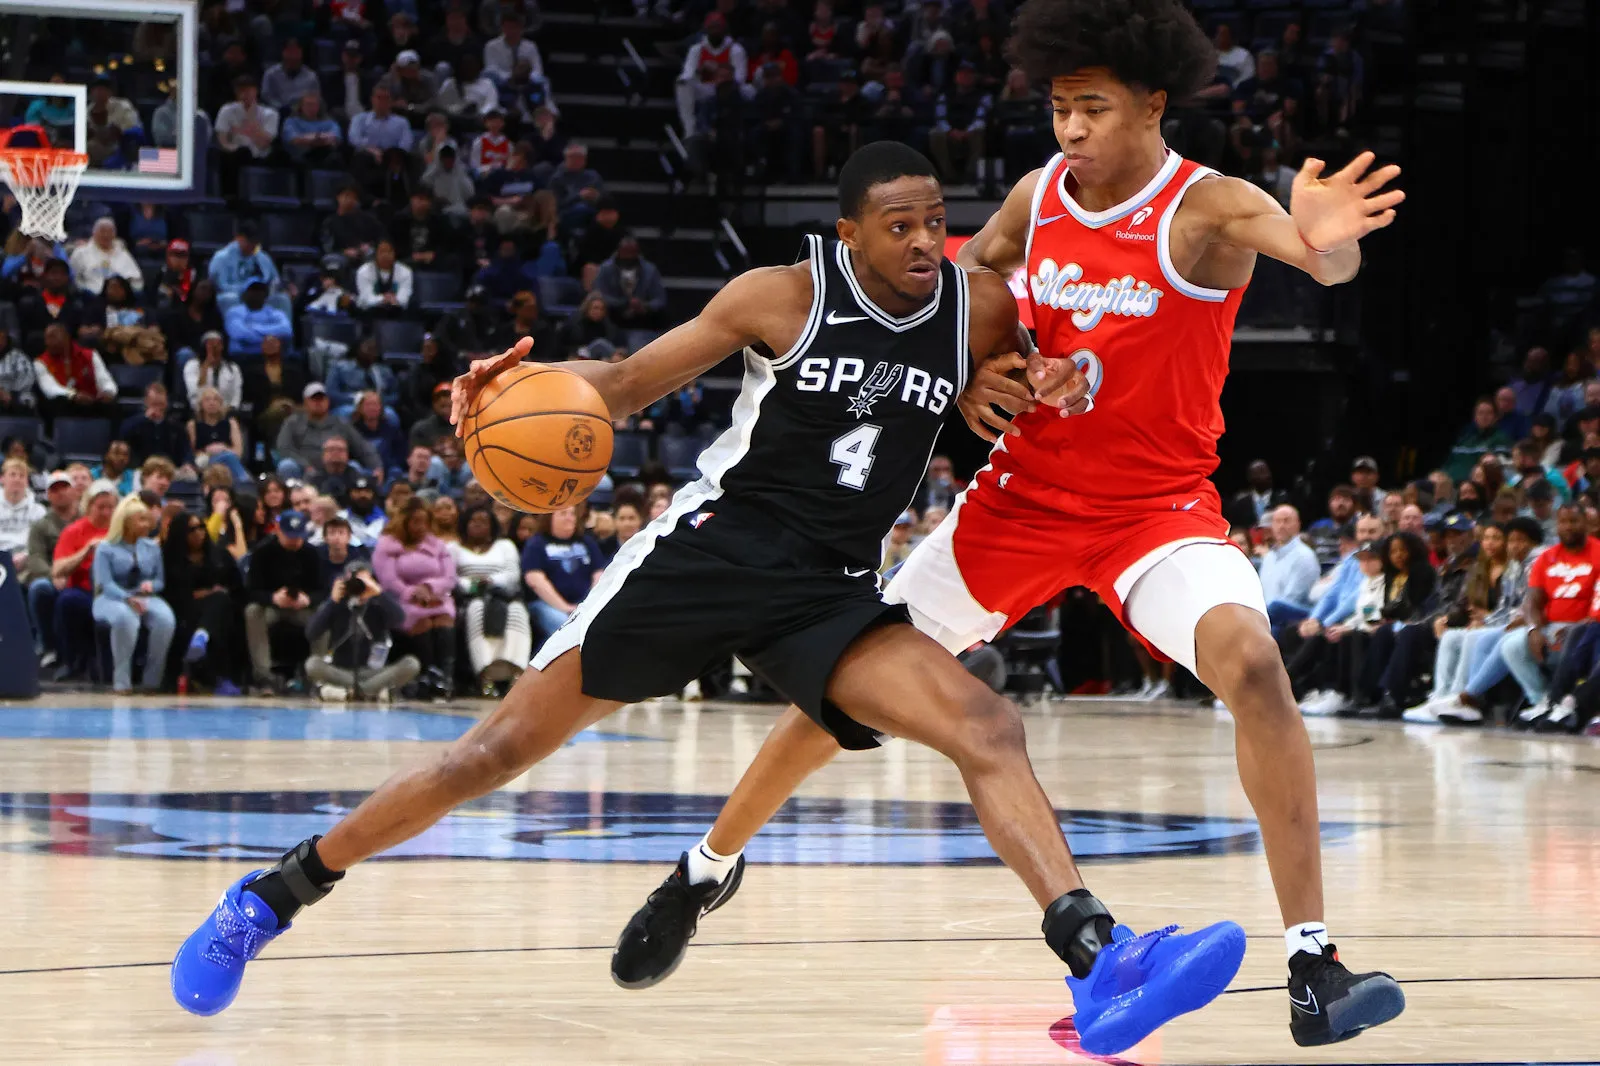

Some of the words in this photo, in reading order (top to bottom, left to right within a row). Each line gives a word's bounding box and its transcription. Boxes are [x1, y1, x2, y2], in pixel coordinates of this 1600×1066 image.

[1115, 230, 1155, 241] Robinhood
[1030, 257, 1164, 332] Memphis
[797, 358, 952, 418] SPURS
[830, 423, 882, 490] 4
